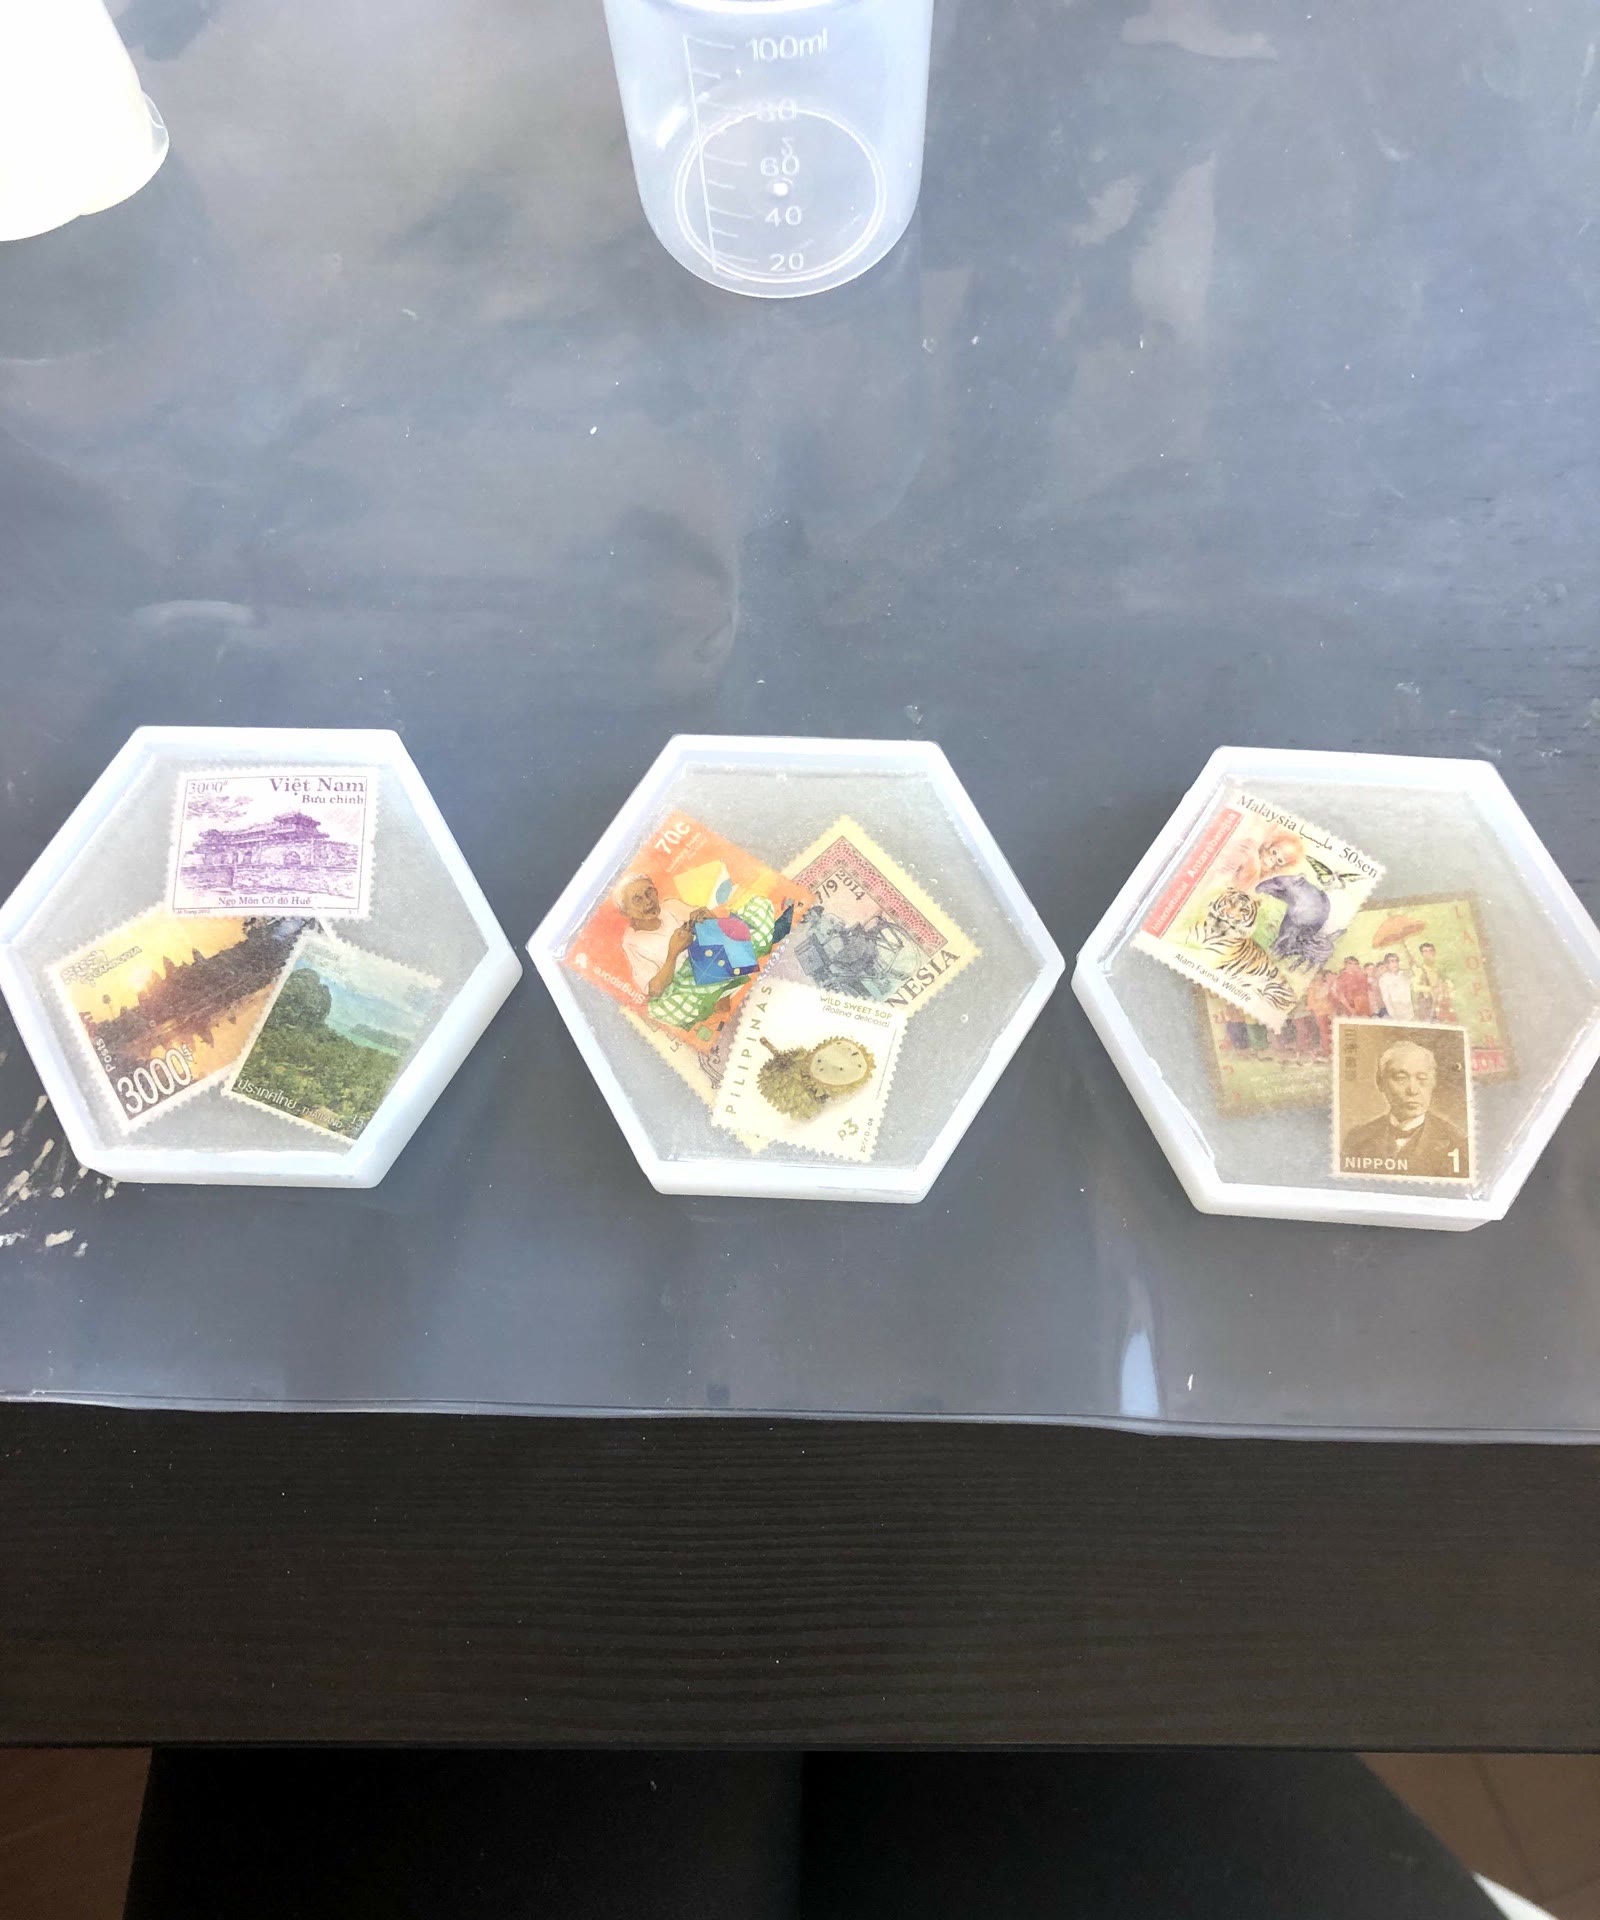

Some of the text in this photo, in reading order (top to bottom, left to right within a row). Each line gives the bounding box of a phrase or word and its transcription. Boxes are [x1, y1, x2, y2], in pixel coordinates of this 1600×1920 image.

[752, 28, 828, 62] 100ml
[760, 156, 800, 176] 60
[764, 206, 803, 227] 40
[769, 252, 804, 272] 20
[269, 777, 365, 796] Việt Nam
[1237, 795, 1298, 832] Malaysia
[835, 869, 867, 901] 2014
[1174, 953, 1195, 970] Alam
[593, 967, 647, 1006] Singapore
[820, 996, 893, 1020] WILD SWEET SOP
[95, 1038, 117, 1074] Posts
[725, 986, 773, 1115] PILIPINAS
[1344, 1156, 1409, 1172] NIPPON
[1447, 1147, 1461, 1174] 1
